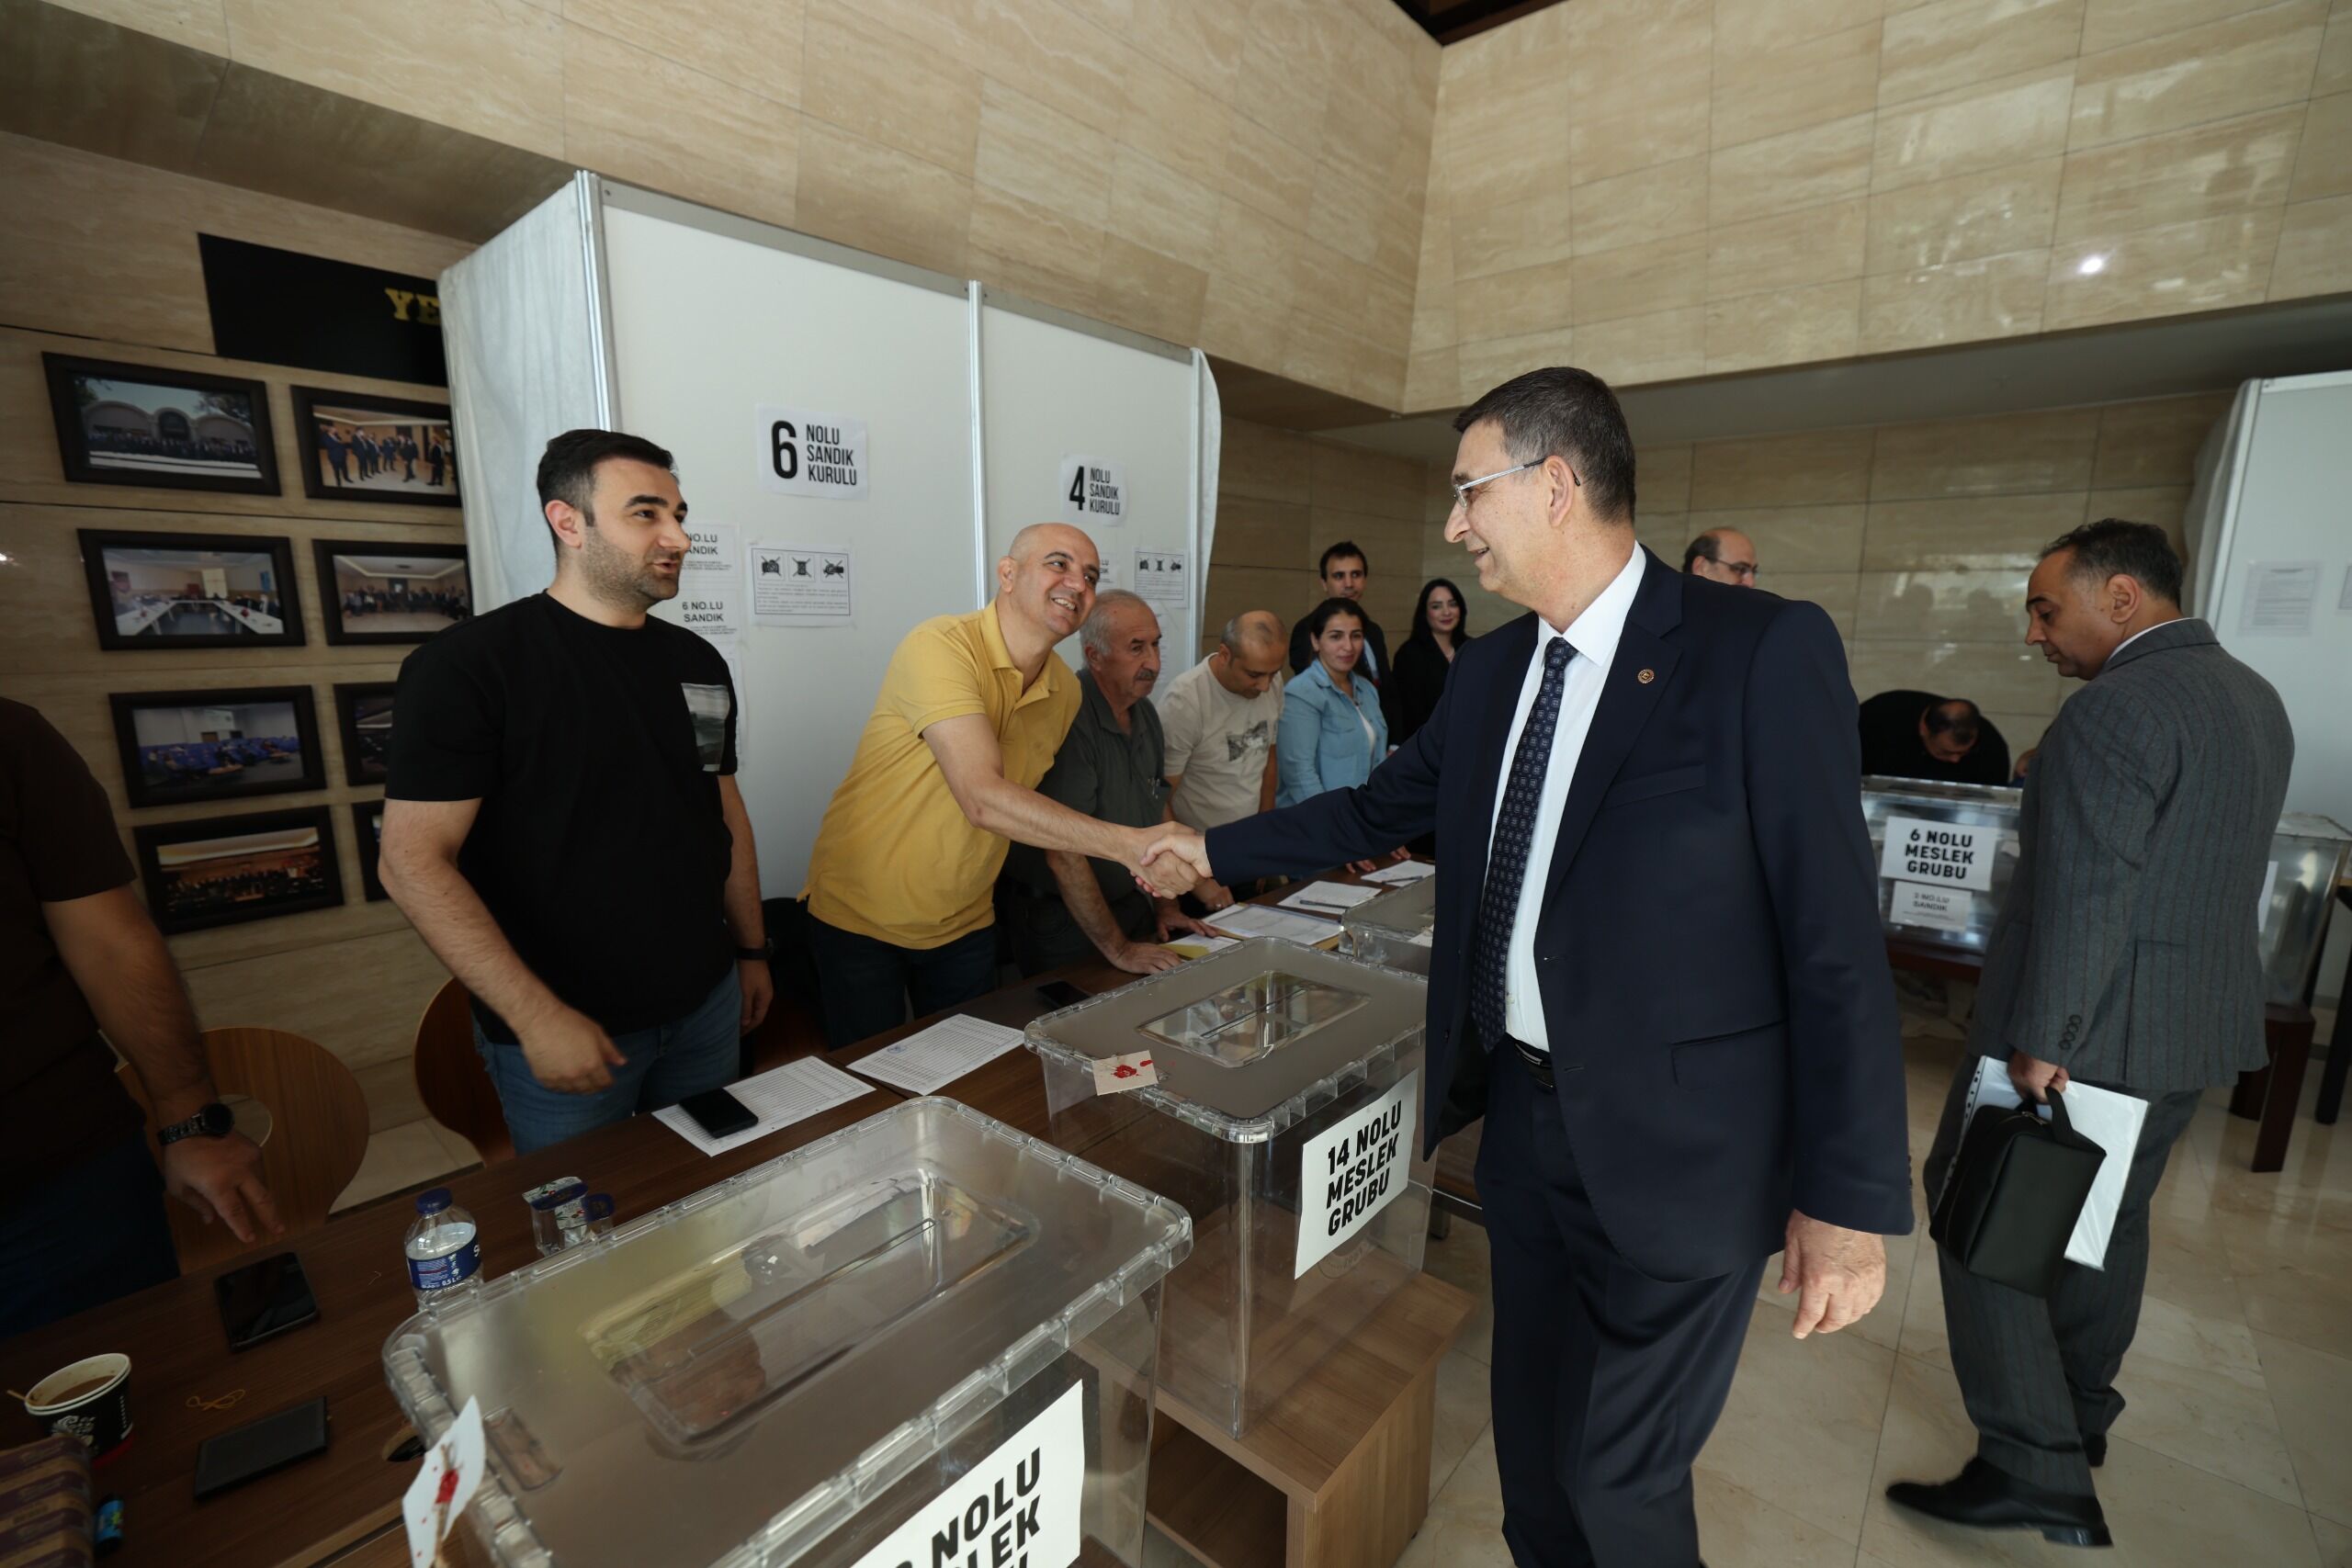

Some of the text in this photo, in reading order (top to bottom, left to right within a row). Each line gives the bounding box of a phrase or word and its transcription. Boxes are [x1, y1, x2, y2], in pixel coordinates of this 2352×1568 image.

[806, 423, 840, 445] NOLU
[771, 420, 797, 479] 6
[807, 445, 854, 466] SANDIK
[808, 464, 857, 486] KURULU
[1090, 468, 1111, 483] NOLU
[1069, 466, 1085, 511] 4
[1090, 483, 1119, 500] SANDIK
[1090, 499, 1120, 515] KURULU
[686, 546, 718, 555] ANDIK
[682, 601, 724, 610] 6 NO.LU
[684, 614, 724, 623] SANDIK
[1910, 829, 1973, 848] 6 NOLU
[1905, 843, 1974, 864] MESLEK
[1907, 860, 1967, 879] GRUBU
[1328, 1100, 1402, 1176] 14 NOLU
[1326, 1133, 1399, 1209] MESLEK
[1328, 1167, 1390, 1236] GRUBU
[932, 1447, 1041, 1568] NOLU
